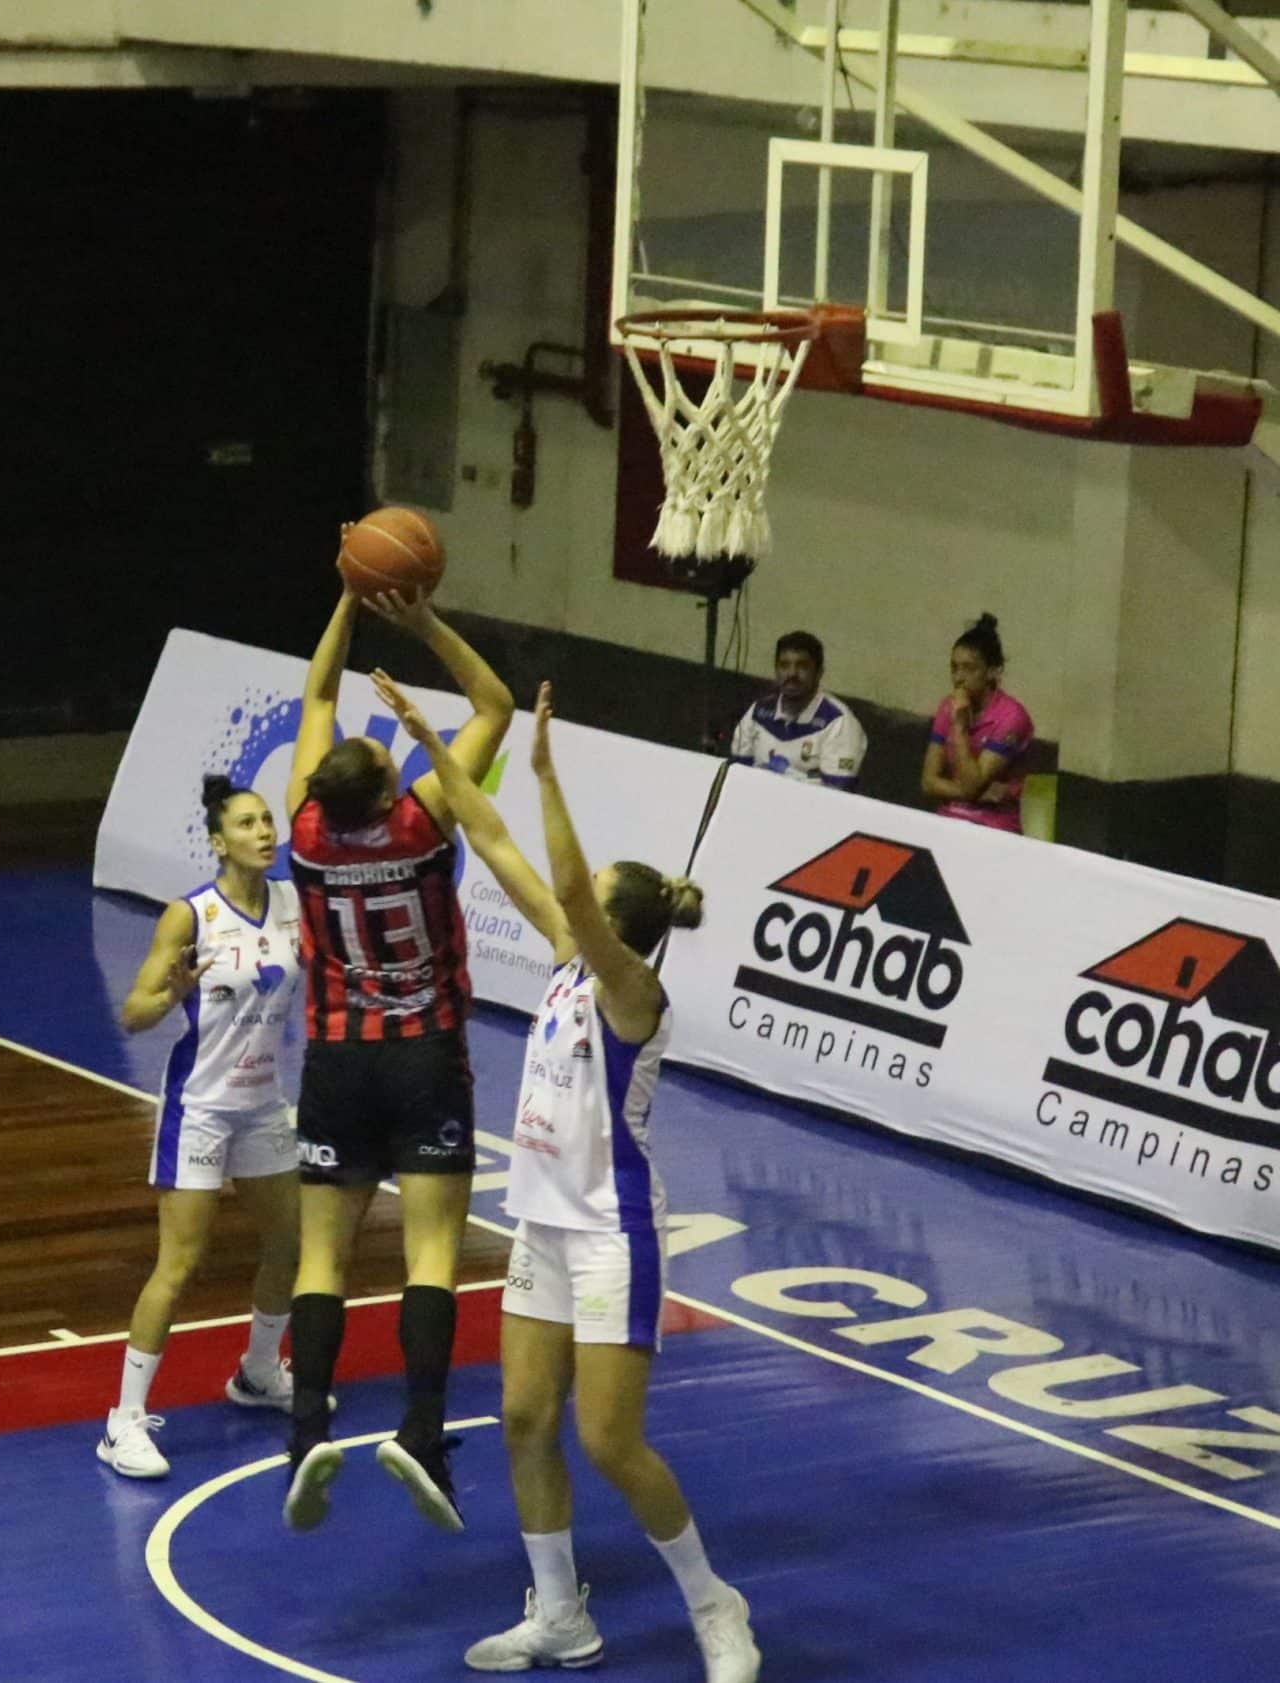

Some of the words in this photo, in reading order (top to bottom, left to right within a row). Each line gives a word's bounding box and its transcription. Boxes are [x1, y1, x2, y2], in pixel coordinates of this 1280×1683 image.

[230, 947, 240, 970] 7
[328, 889, 433, 971] 13
[464, 904, 522, 941] Ituana
[476, 938, 554, 980] Saneament
[753, 902, 964, 1010] cohab
[728, 997, 935, 1089] Campinas
[1035, 1091, 1275, 1192] Campinas
[730, 1265, 1280, 1481] CRUZ
